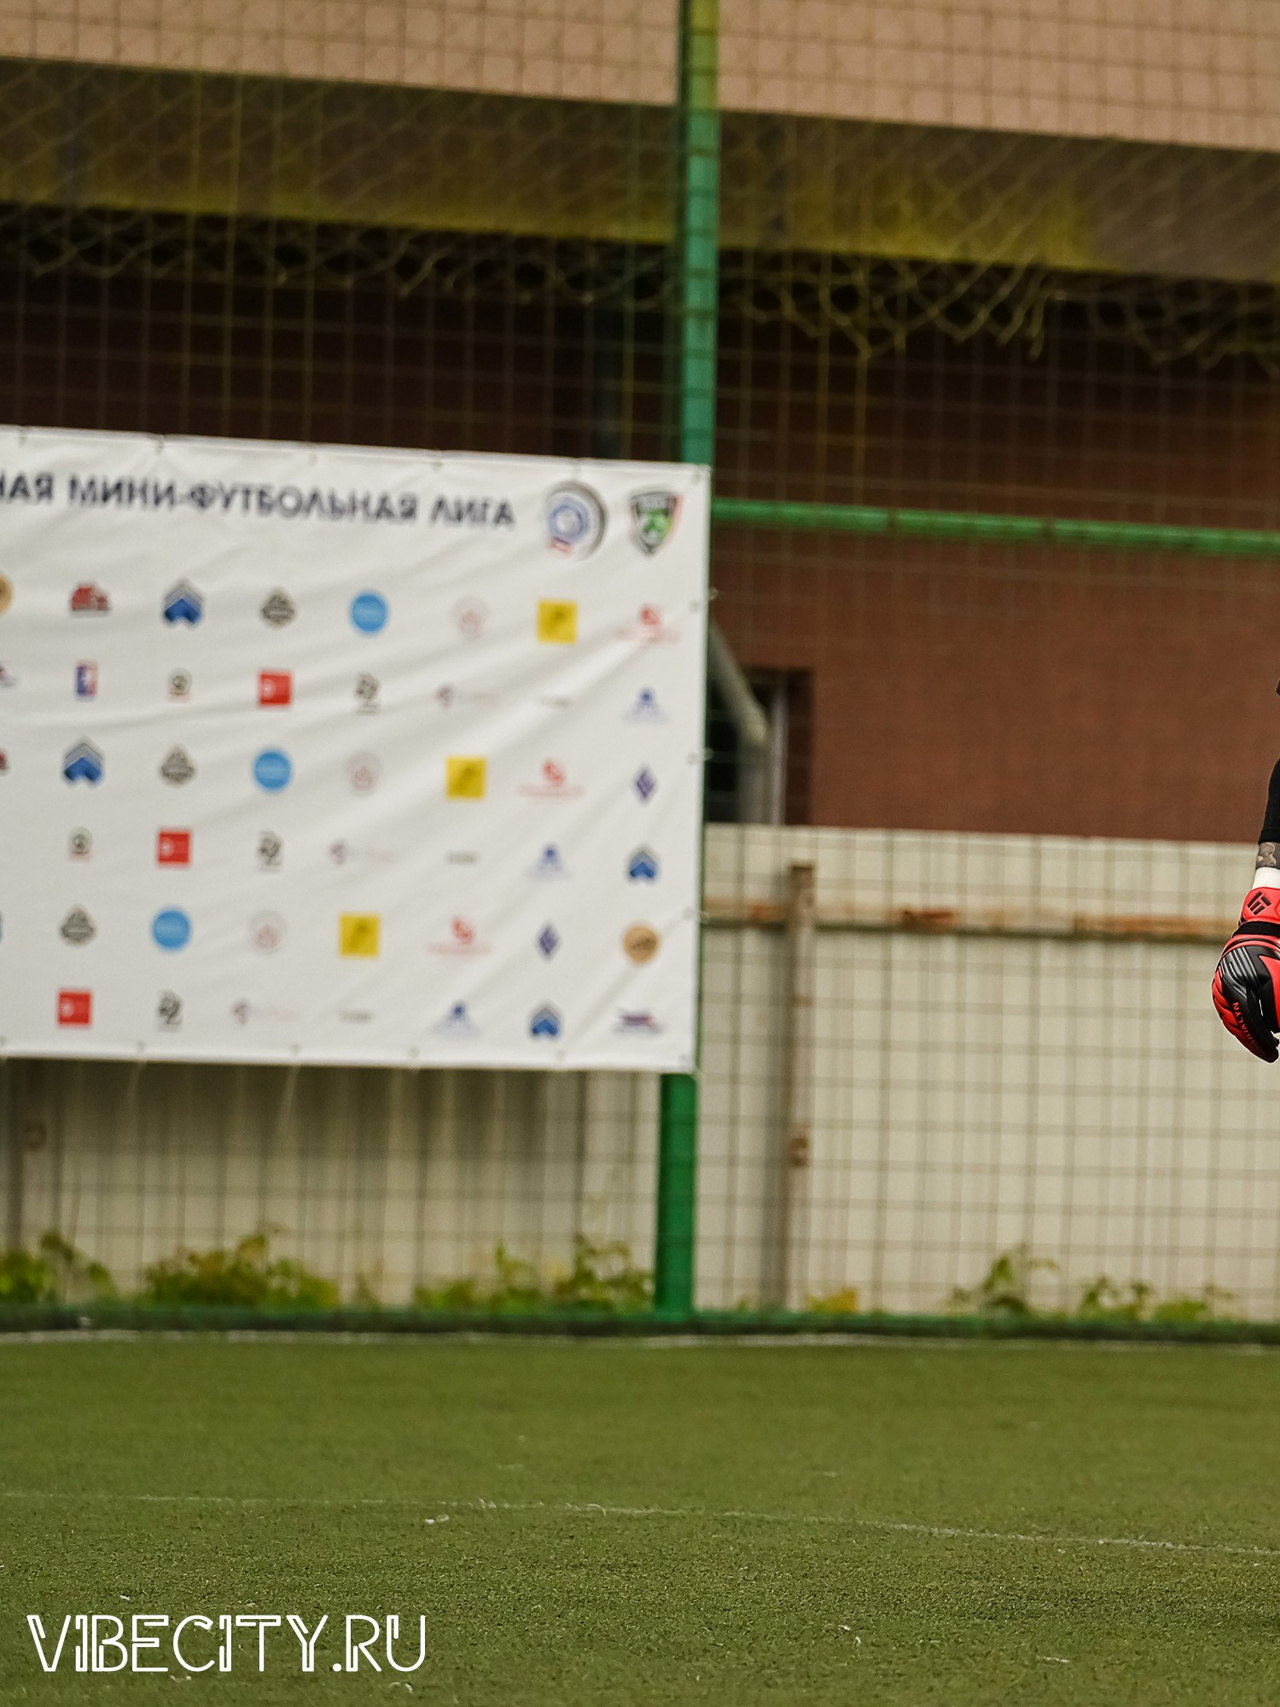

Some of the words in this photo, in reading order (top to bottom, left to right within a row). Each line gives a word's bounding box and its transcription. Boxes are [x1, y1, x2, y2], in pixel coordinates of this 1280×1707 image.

[0, 470, 54, 504] АЯ
[68, 473, 418, 526] МИНИ-ФУТБОЛЬНАЯ
[428, 492, 518, 531] ЛИГА
